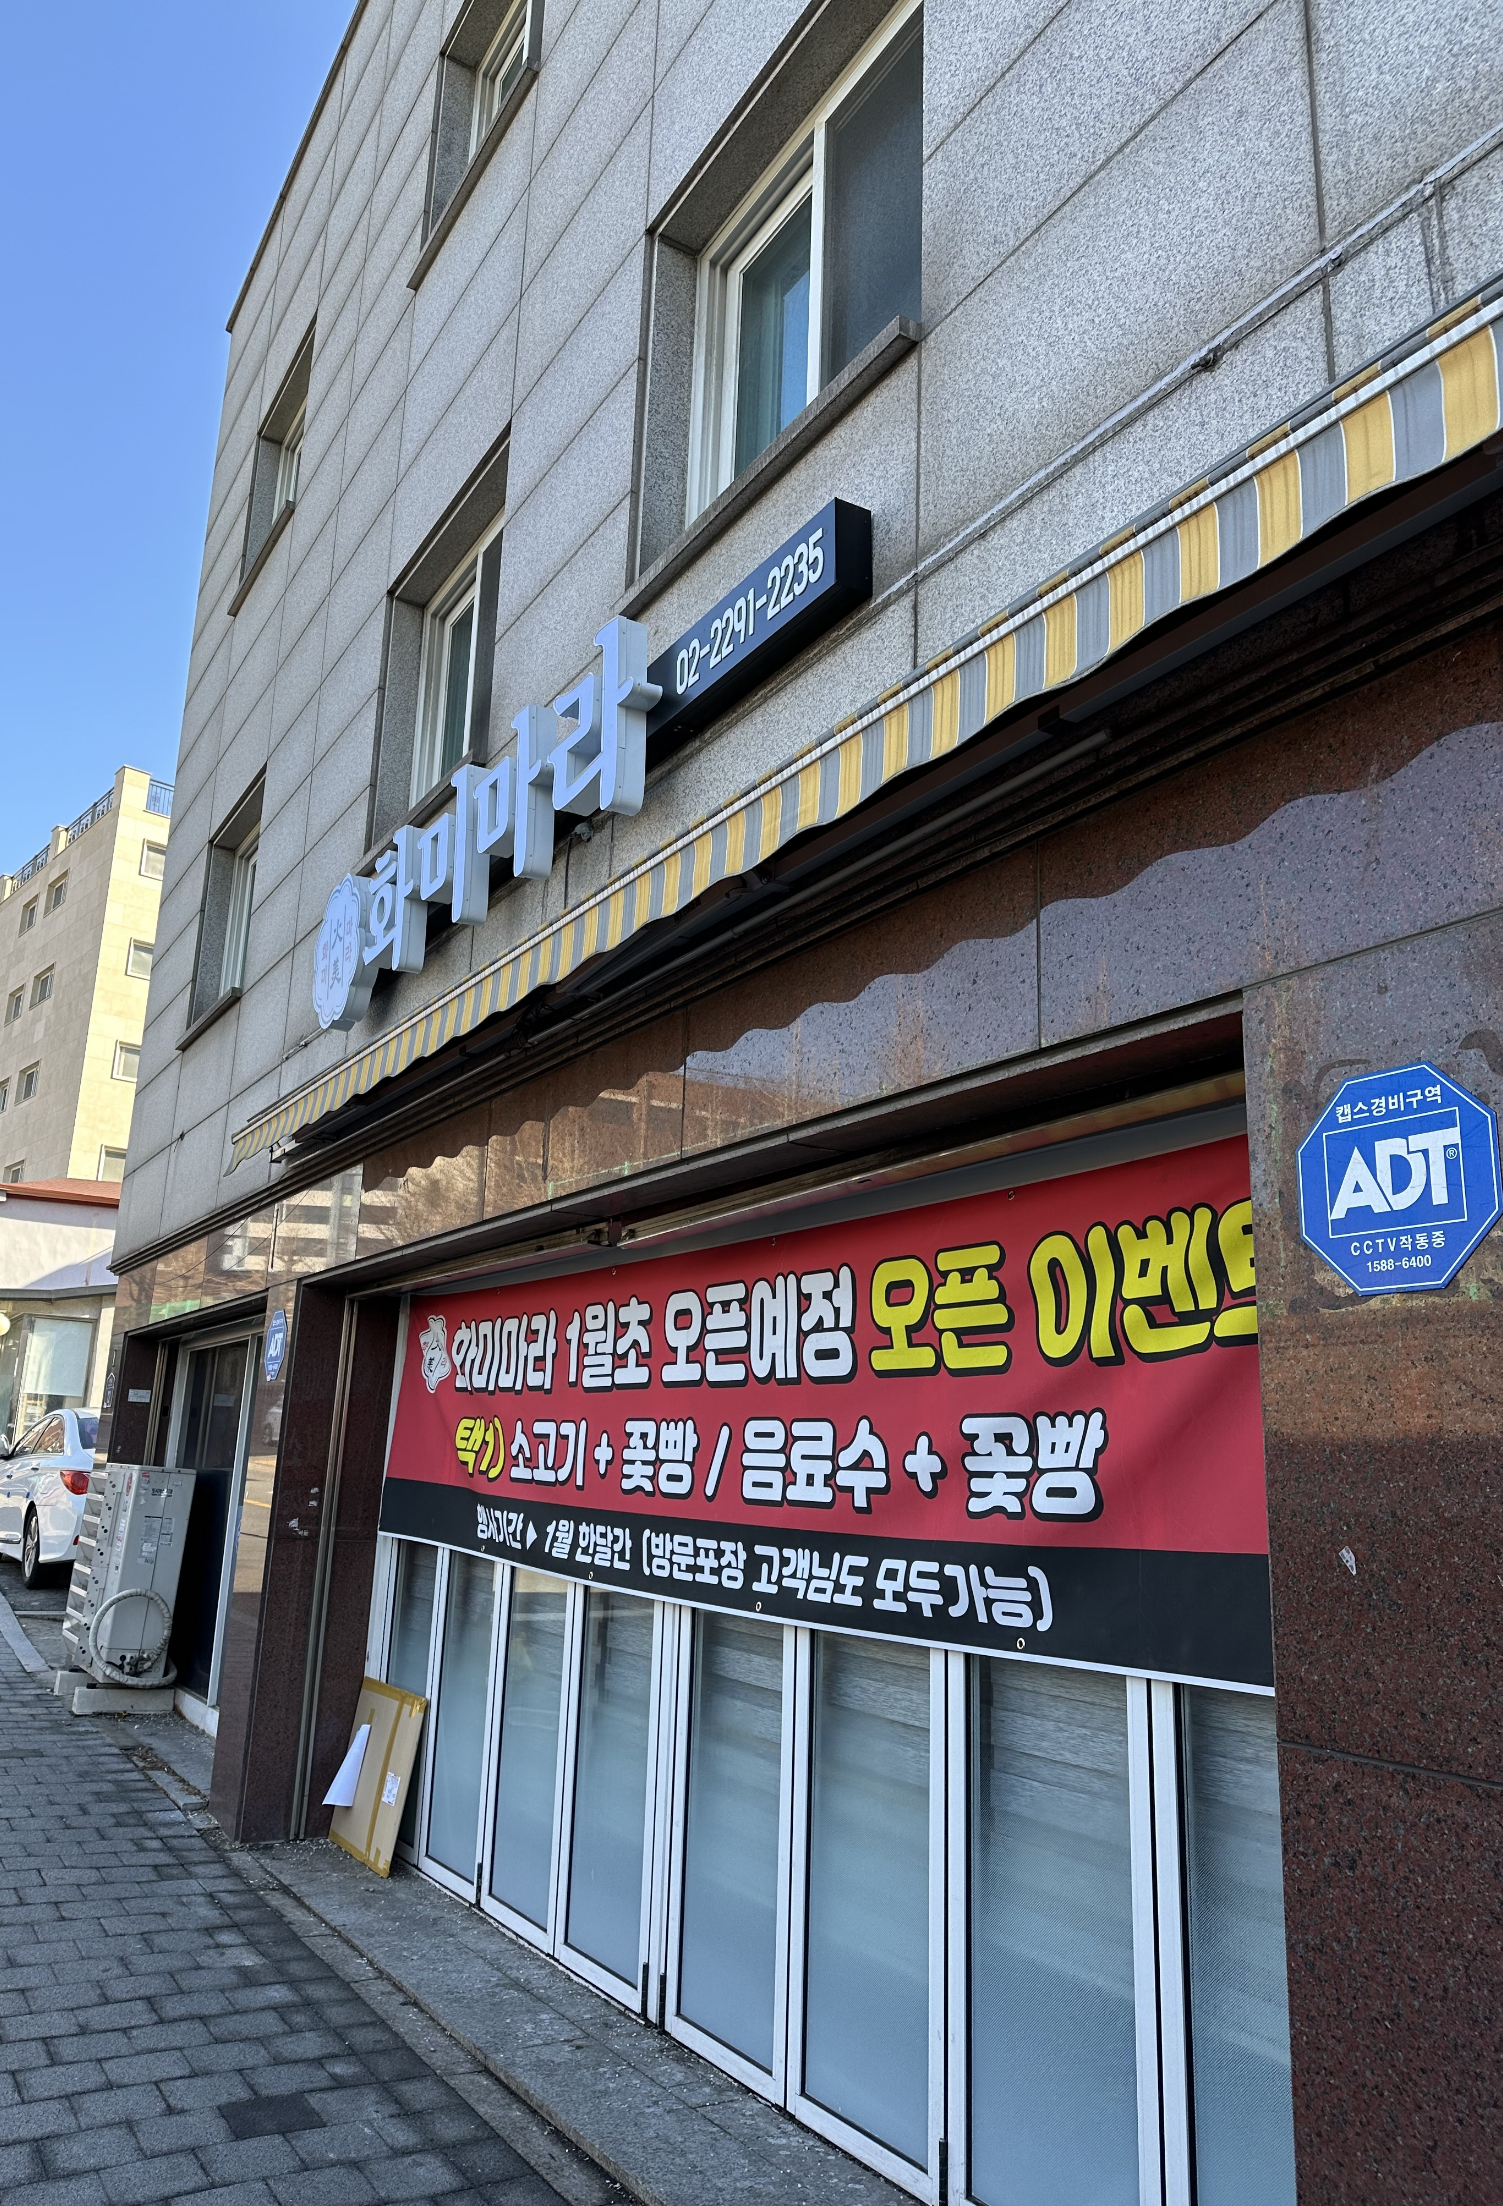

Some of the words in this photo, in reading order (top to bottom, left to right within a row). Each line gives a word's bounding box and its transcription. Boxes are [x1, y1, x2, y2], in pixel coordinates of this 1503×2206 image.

[676, 527, 824, 696] 02-2291-2235
[363, 616, 656, 974] 화미마라
[1335, 1084, 1442, 1124] 캡스경비구역
[1330, 1127, 1461, 1220] ADT
[1350, 1230, 1446, 1256] CCTV작동중
[1366, 1254, 1432, 1273] 1588-6400
[451, 1309, 557, 1391] 화미마라
[565, 1296, 651, 1388] 1월초
[661, 1265, 855, 1383] 오픈예정
[869, 1244, 1009, 1372] 오픈
[510, 1419, 587, 1487] 소고기
[593, 1432, 613, 1476] +
[621, 1419, 698, 1494] 꽃빵
[704, 1423, 730, 1497] /
[741, 1417, 888, 1508] 음료수
[904, 1434, 942, 1492] +
[961, 1411, 1105, 1515] 꽃빵
[477, 1502, 524, 1549] 행사기간
[544, 1519, 574, 1559] 1월
[575, 1521, 632, 1570] 한달간
[642, 1528, 747, 1589] (방문포장
[751, 1544, 869, 1607] 고객님도
